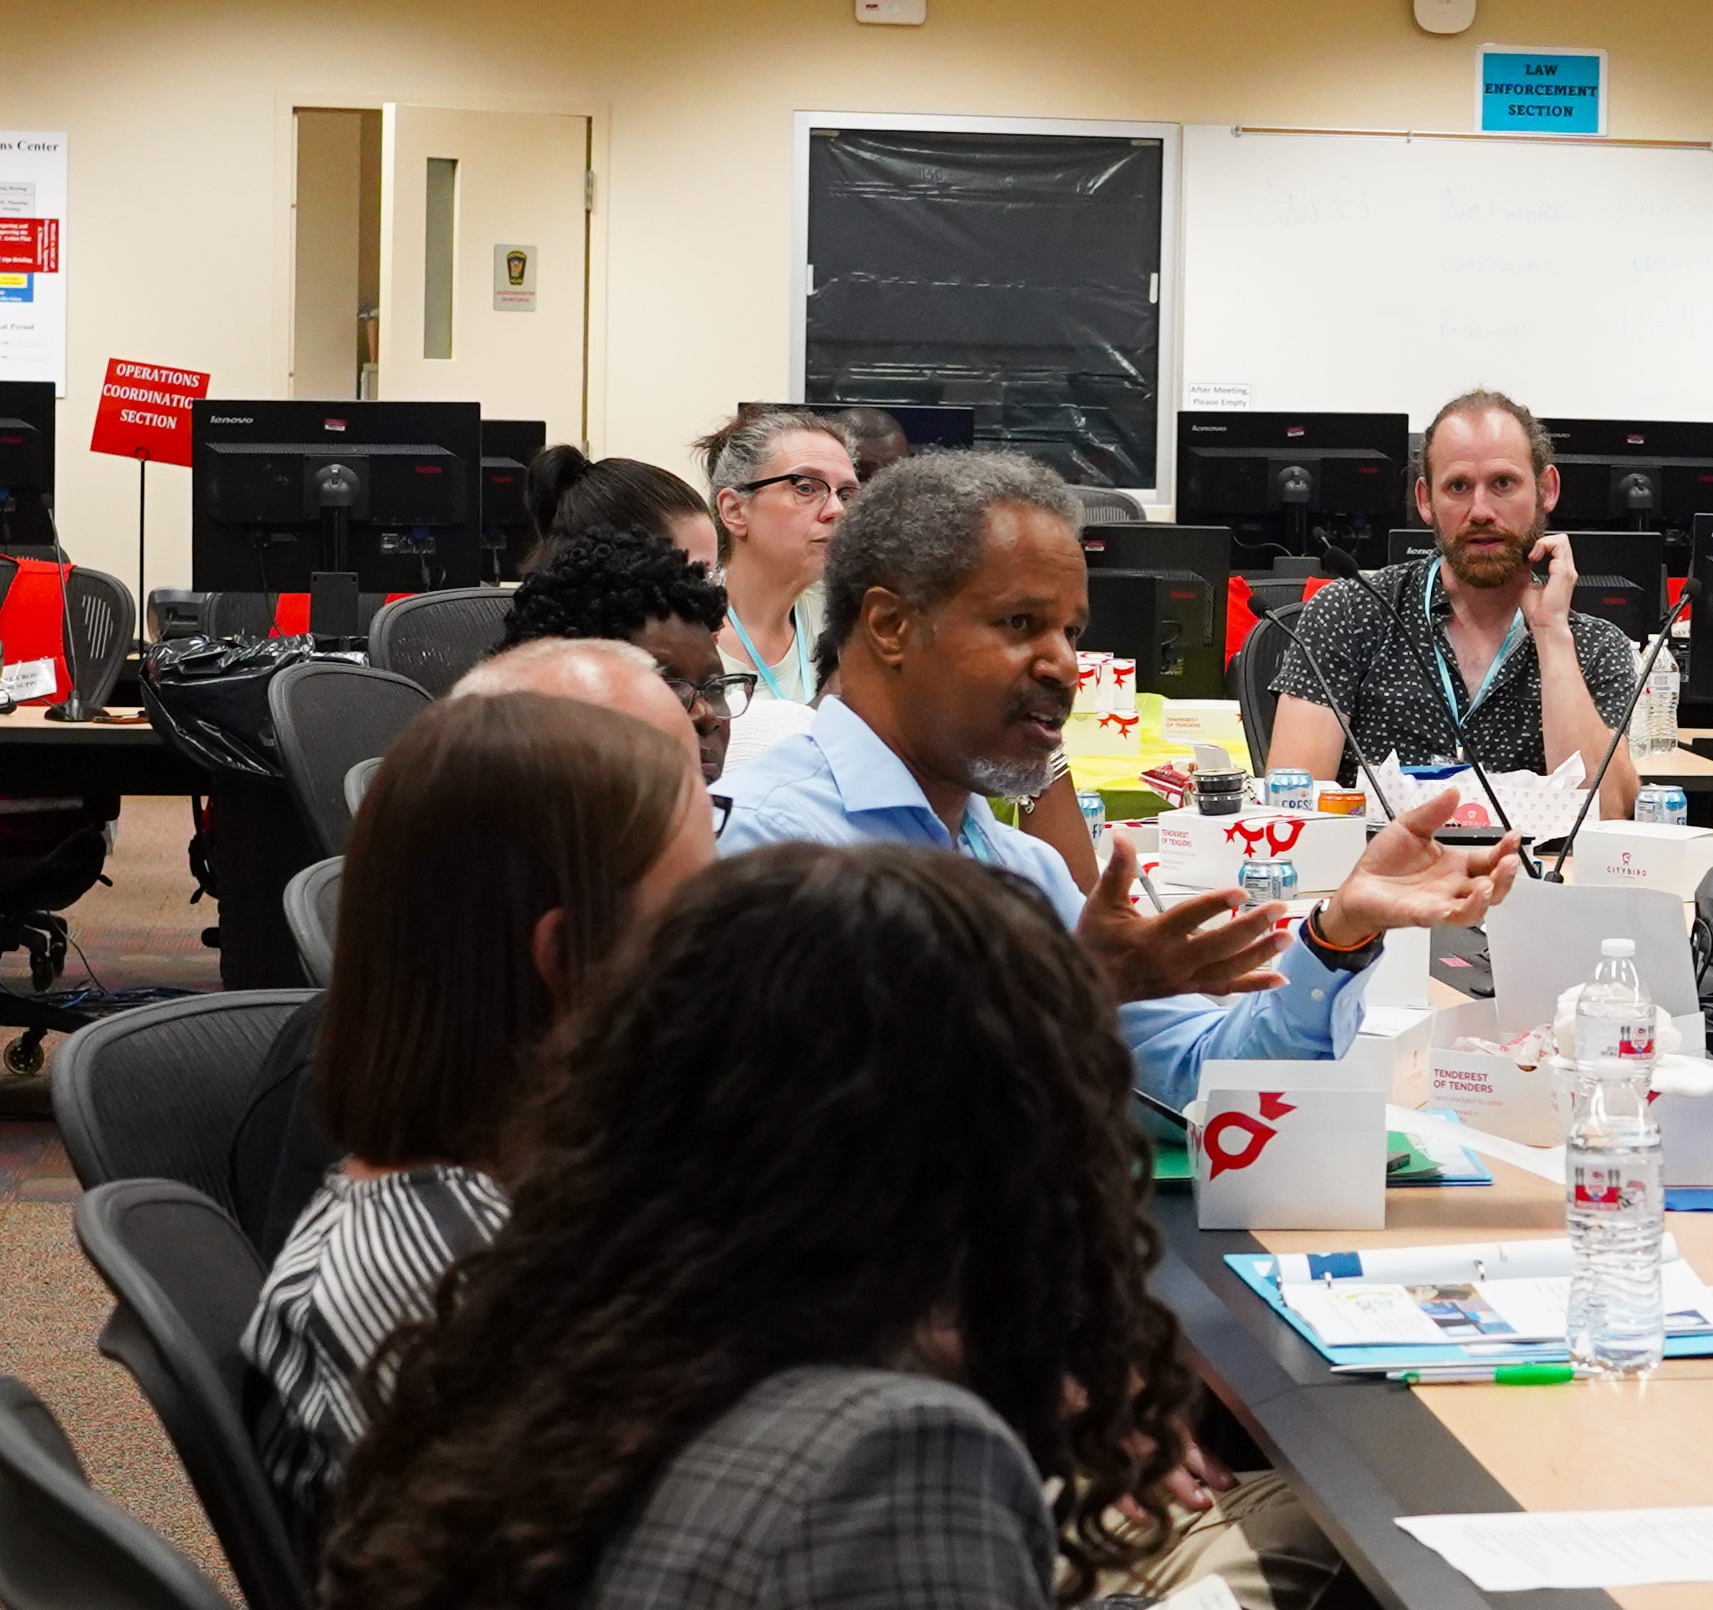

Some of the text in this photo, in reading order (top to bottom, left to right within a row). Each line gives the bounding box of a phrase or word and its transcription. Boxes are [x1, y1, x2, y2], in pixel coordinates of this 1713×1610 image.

[1525, 64, 1558, 76] LAW
[1484, 83, 1598, 97] ENFORCEMENT
[1508, 104, 1574, 117] SECTION
[17, 140, 59, 152] Center
[116, 363, 200, 388] OPERATIONS
[102, 383, 194, 409] COORDINATIO
[1191, 386, 1211, 394] After
[1193, 398, 1247, 408] Please Empty
[120, 409, 178, 430] SECTION
[210, 415, 254, 424] lenovo
[1406, 547, 1434, 555] leno
[1607, 866, 1647, 877] CITYBIRD
[1434, 1068, 1488, 1082] TENDEREST
[1433, 1079, 1493, 1094] OF TENDERS
